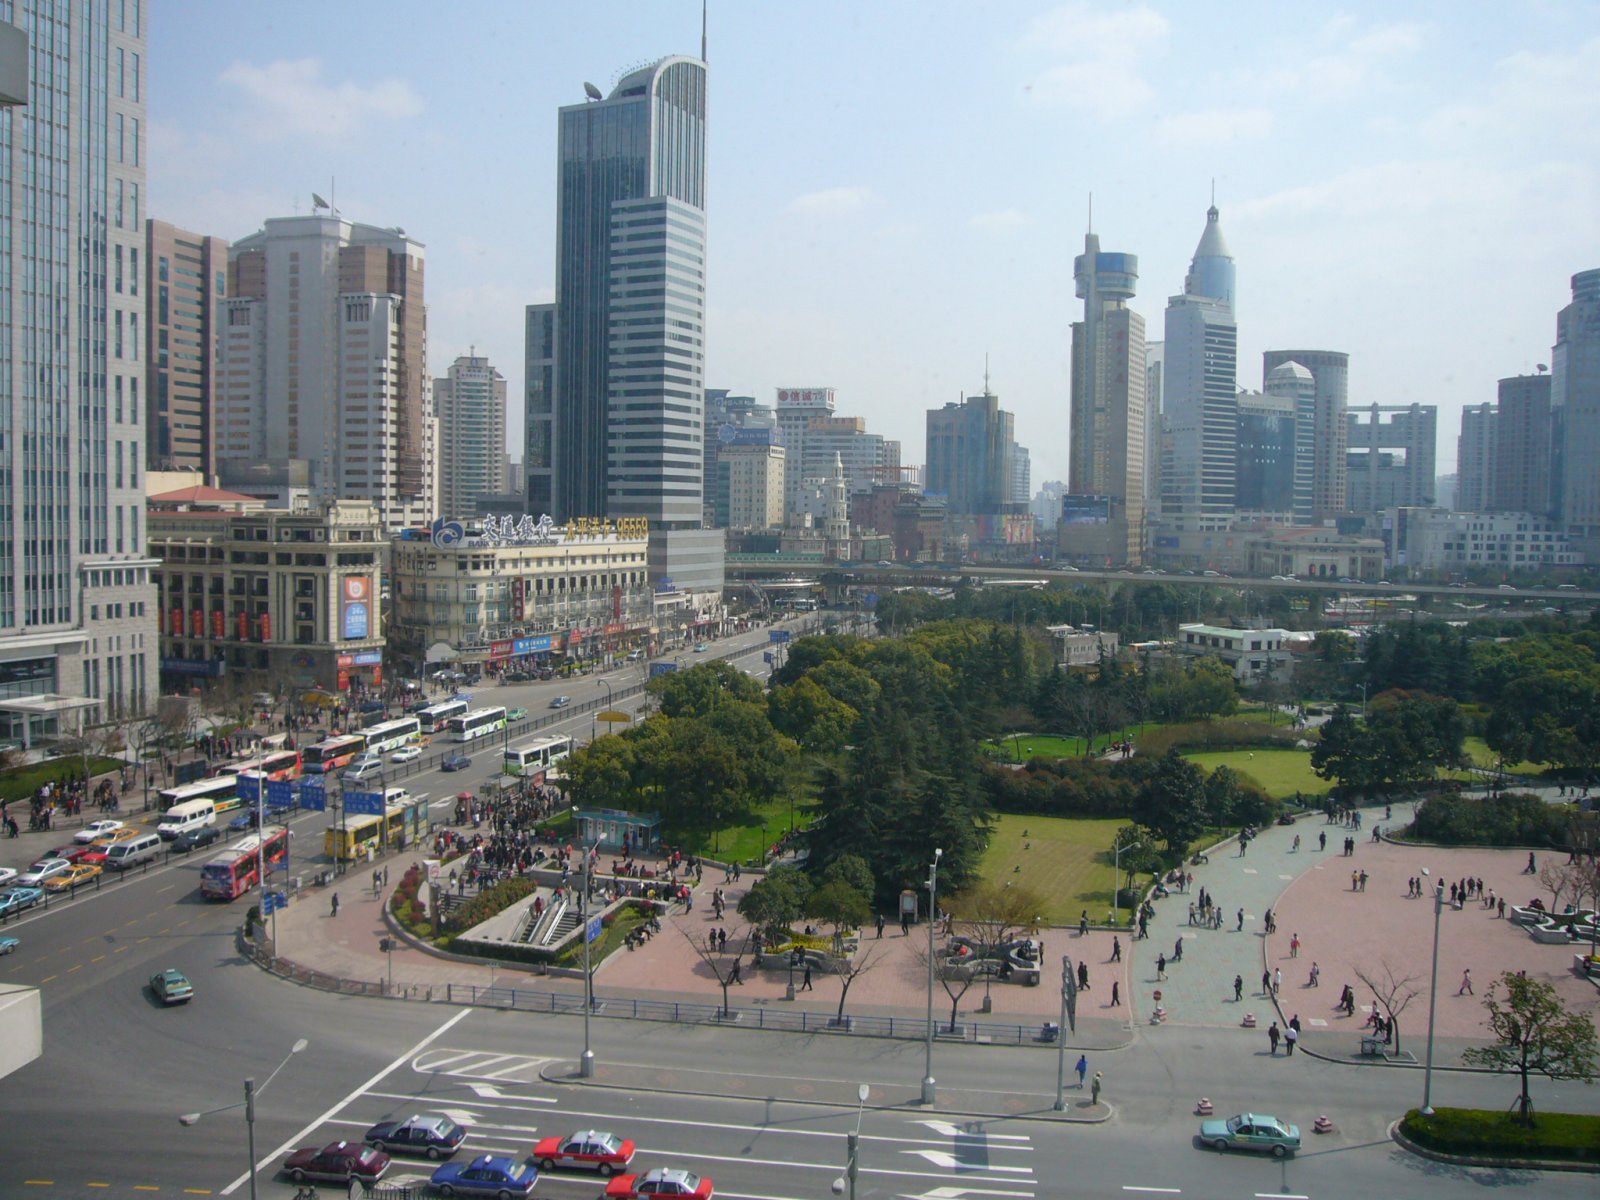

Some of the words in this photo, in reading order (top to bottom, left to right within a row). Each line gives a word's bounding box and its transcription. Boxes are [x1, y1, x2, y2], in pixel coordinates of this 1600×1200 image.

[481, 513, 554, 541] 交通銀行
[565, 517, 612, 540] 太平洋卡
[617, 516, 648, 540] 95559
